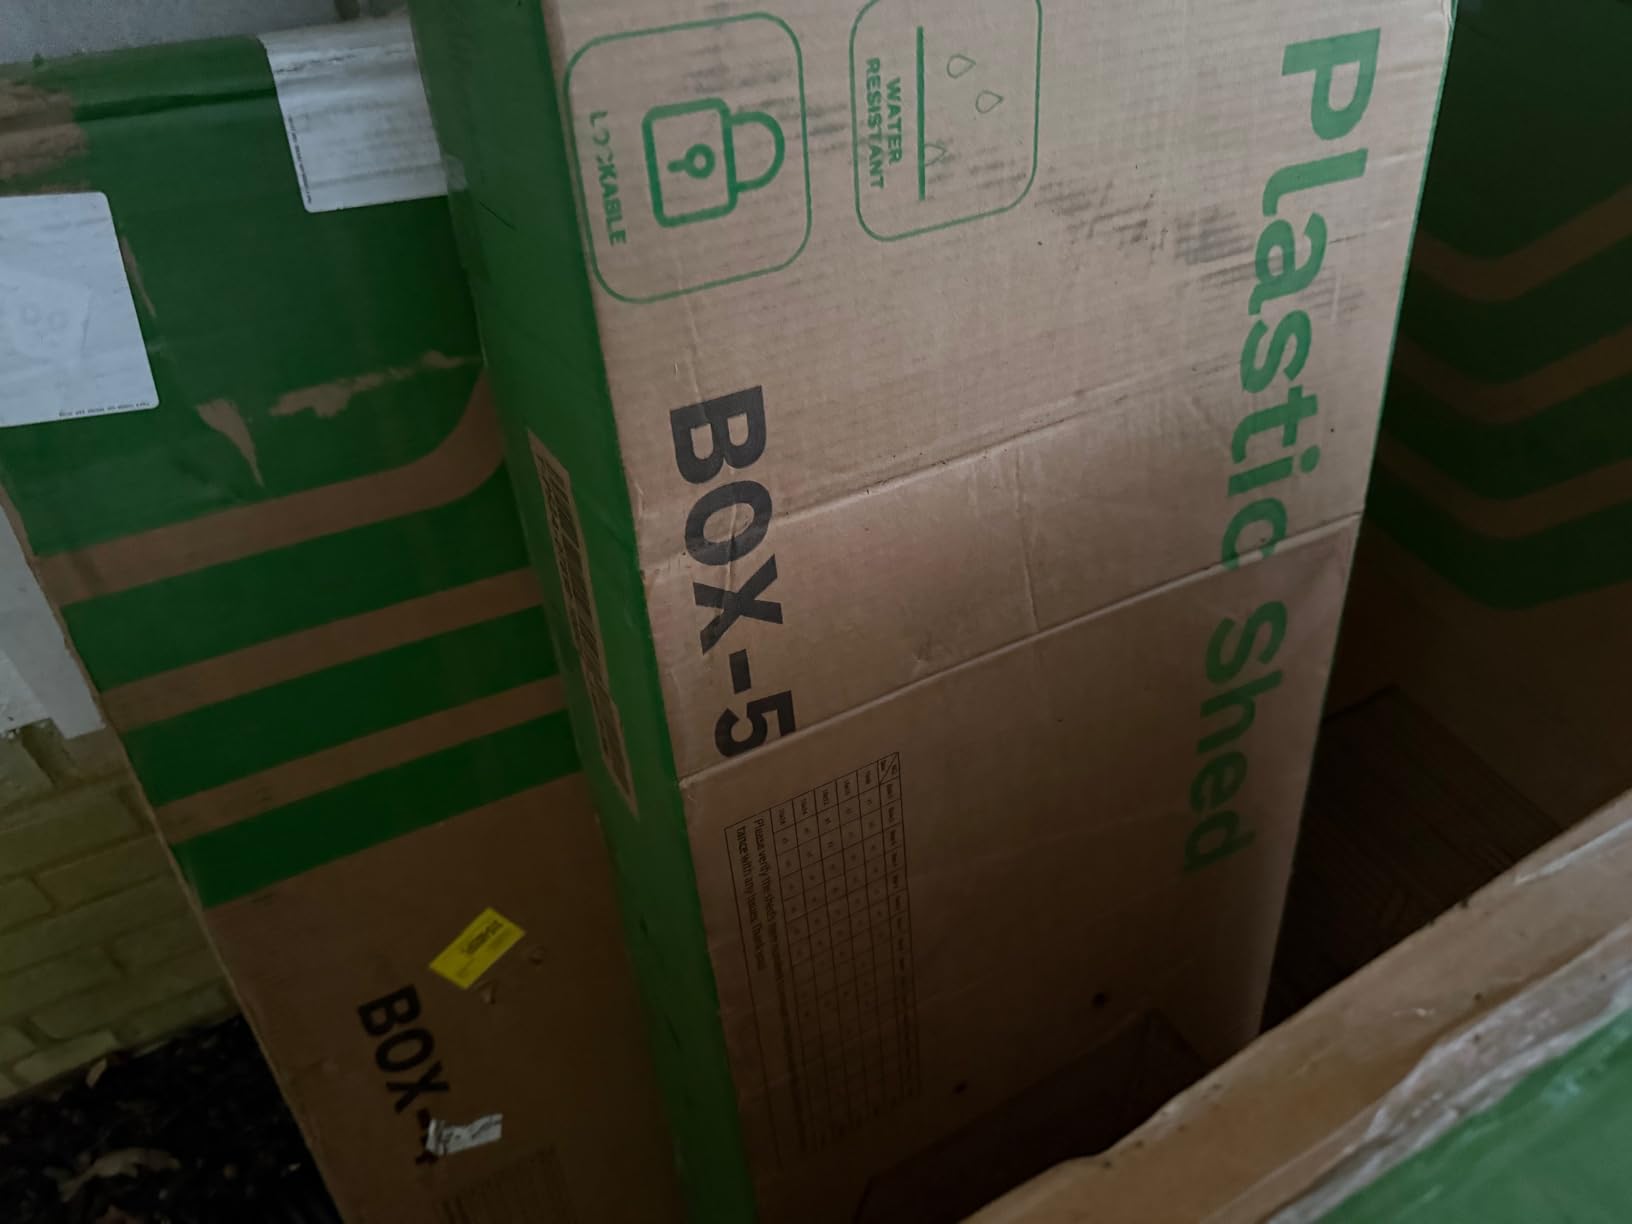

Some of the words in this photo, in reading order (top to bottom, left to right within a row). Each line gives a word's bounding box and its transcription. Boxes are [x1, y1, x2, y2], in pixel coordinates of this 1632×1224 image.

[867, 57, 886, 188] RESISTANT
[886, 79, 903, 162] WATER
[1223, 28, 1381, 569] Plastic
[670, 385, 796, 758] BOX-5
[1183, 601, 1287, 875] Shed
